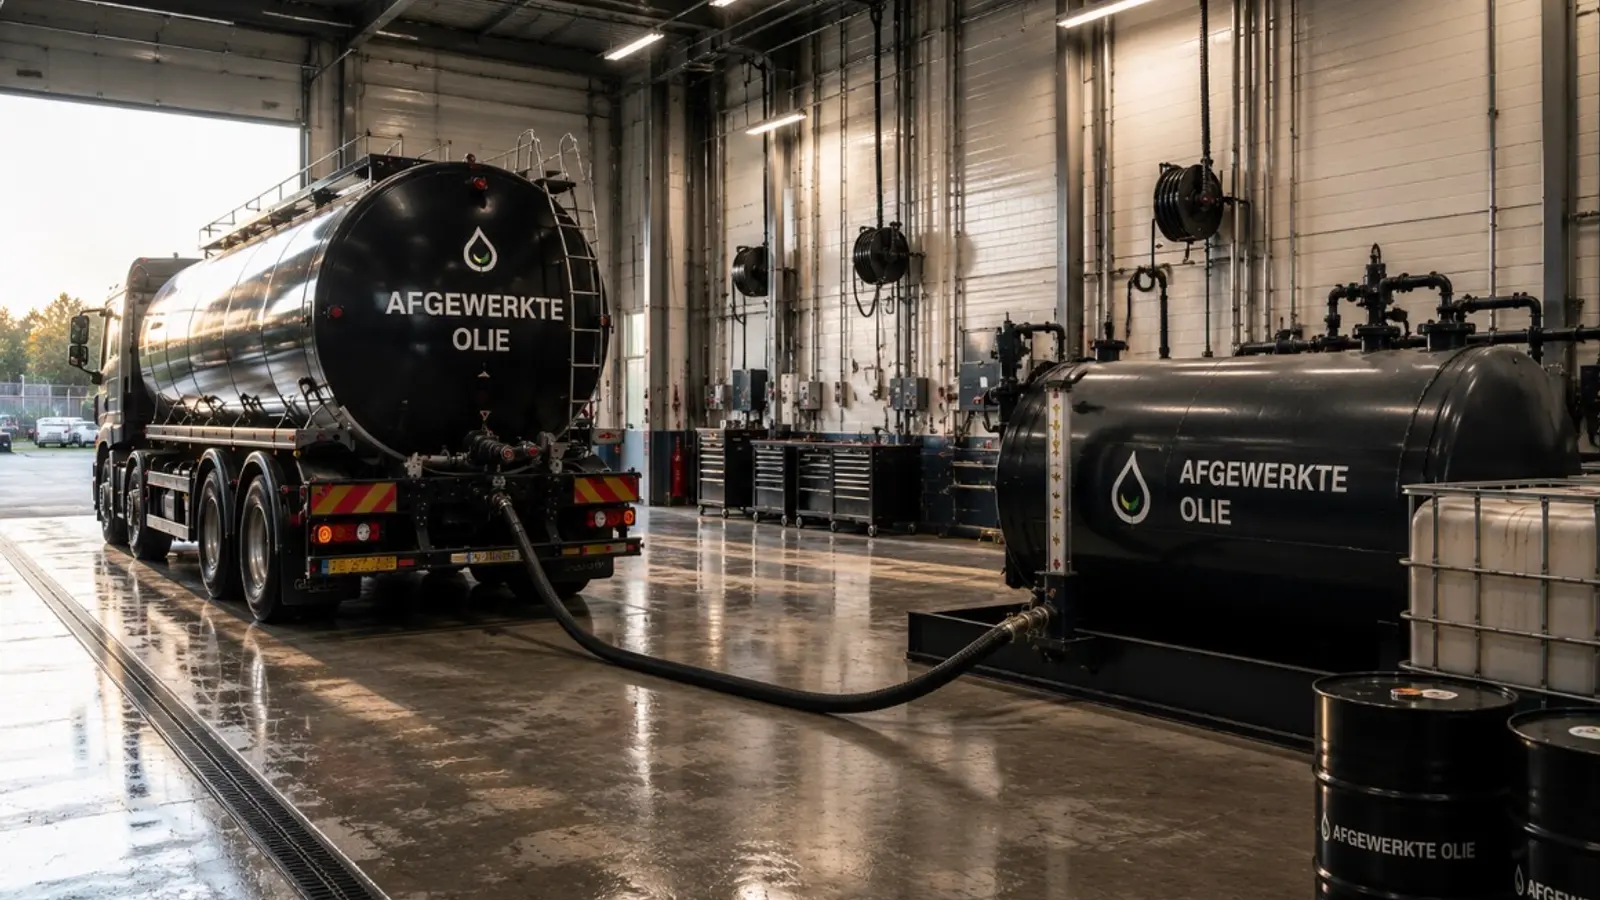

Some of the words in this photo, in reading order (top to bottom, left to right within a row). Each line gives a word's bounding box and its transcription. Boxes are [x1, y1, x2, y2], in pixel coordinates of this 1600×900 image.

[386, 291, 564, 320] AFGEWERKTE
[453, 328, 510, 352] OLIE
[1180, 460, 1349, 493] AFGEWERKTE
[1180, 497, 1231, 525] OLIE
[1333, 825, 1436, 859] AFGEWERKTE
[1441, 842, 1476, 860] OLIE
